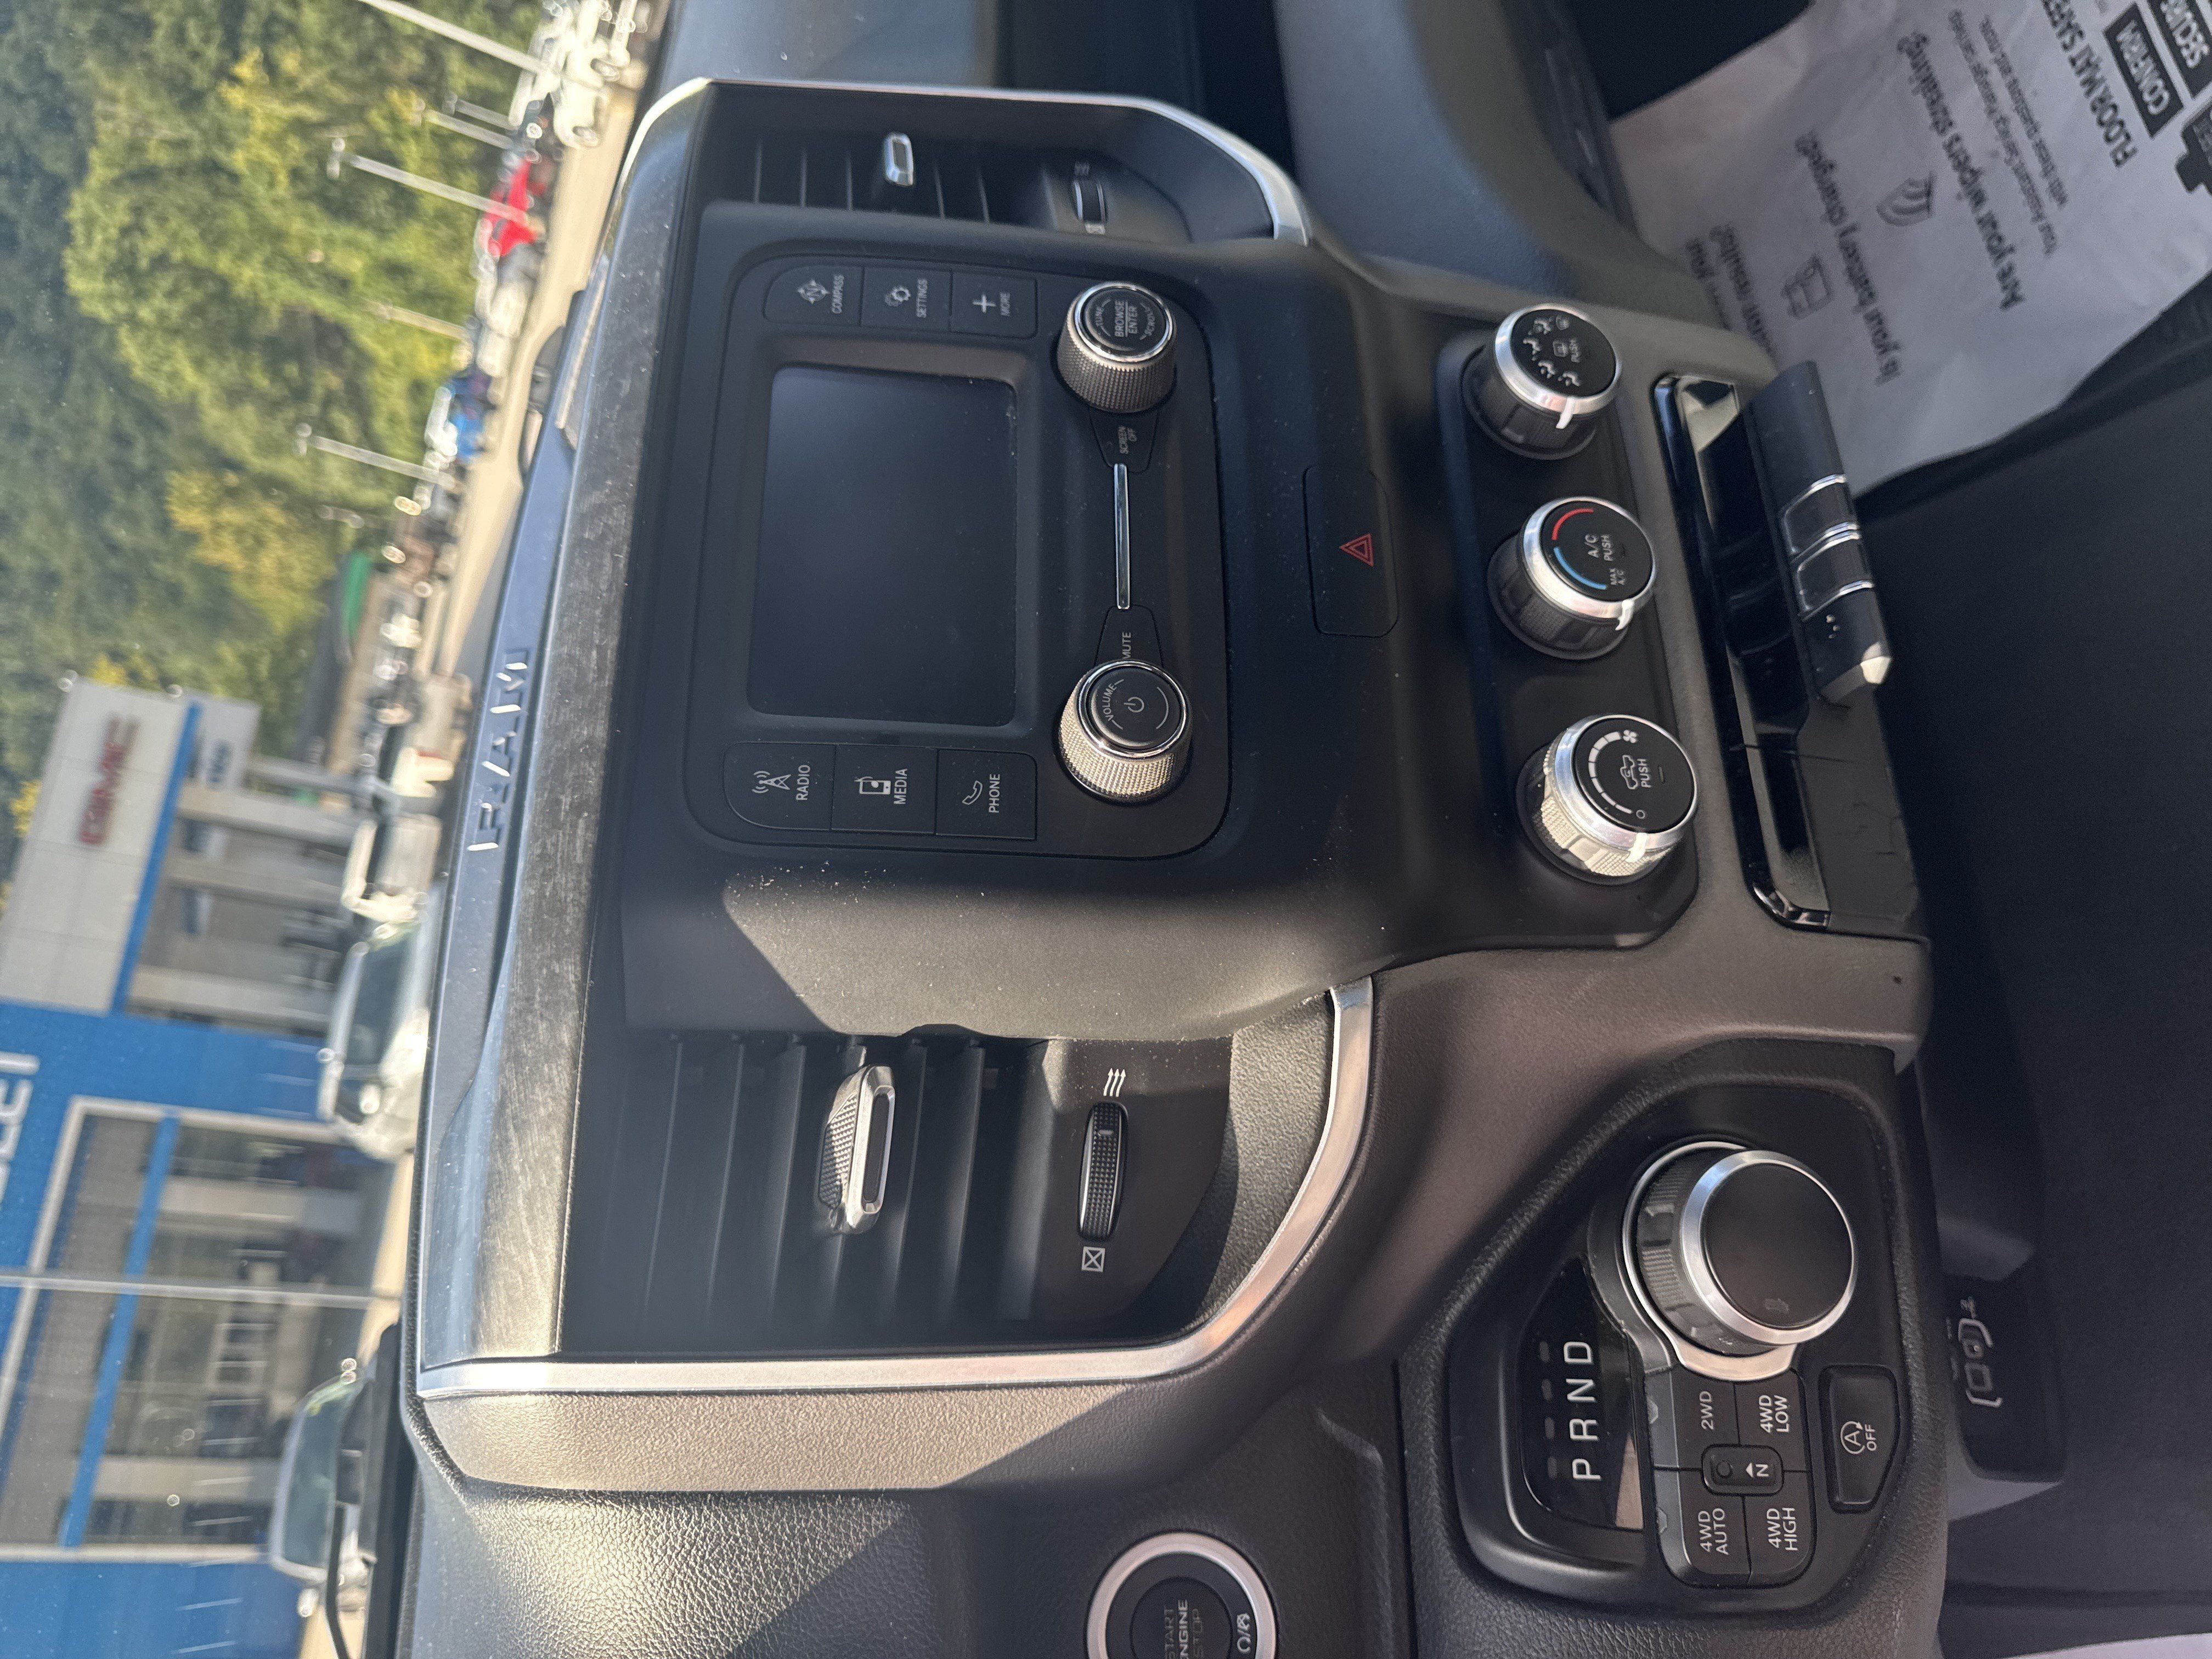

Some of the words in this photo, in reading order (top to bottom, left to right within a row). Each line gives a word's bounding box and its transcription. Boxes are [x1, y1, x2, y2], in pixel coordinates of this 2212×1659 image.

[2066, 43, 2106, 99] MAT
[2115, 19, 2170, 115] CONFIRM
[2089, 84, 2138, 168] FLOOR
[1942, 133, 1988, 215] wipers
[1976, 211, 2018, 265] your
[1835, 221, 1877, 314] battery
[1995, 262, 2025, 311] Are
[832, 274, 845, 314] COMPASS
[916, 278, 928, 318] SETTINGS
[1000, 292, 1011, 317] MORE
[1114, 299, 1125, 337] BROWSE
[1127, 305, 1138, 335] ENTER
[1864, 308, 1903, 357] your
[1584, 534, 1600, 558] A/C
[1600, 534, 1613, 561] PUSH
[1609, 568, 1617, 585] MAX
[1102, 683, 1118, 721] VOLUME
[467, 648, 528, 852] RAM
[795, 764, 811, 800] RADIO
[893, 768, 908, 804] MEDIA
[1637, 758, 1652, 788] PUSH
[988, 773, 1000, 814] PHONE
[1563, 1341, 1594, 1364] D
[1565, 1378, 1596, 1402] N
[1569, 1418, 1600, 1441] R
[1699, 1391, 1714, 1430] 2WD
[1758, 1395, 1774, 1434] 4WD
[1774, 1395, 1790, 1433] LOW
[1864, 1423, 1877, 1451] OFF
[1571, 1458, 1602, 1480] P
[1755, 1464, 1769, 1477] N
[1697, 1511, 1712, 1552] 4WD
[1712, 1508, 1729, 1555] AUTO
[1766, 1508, 1782, 1548] 4WD
[1782, 1507, 1798, 1551] HIGH
[1178, 1599, 1189, 1659] NGINE
